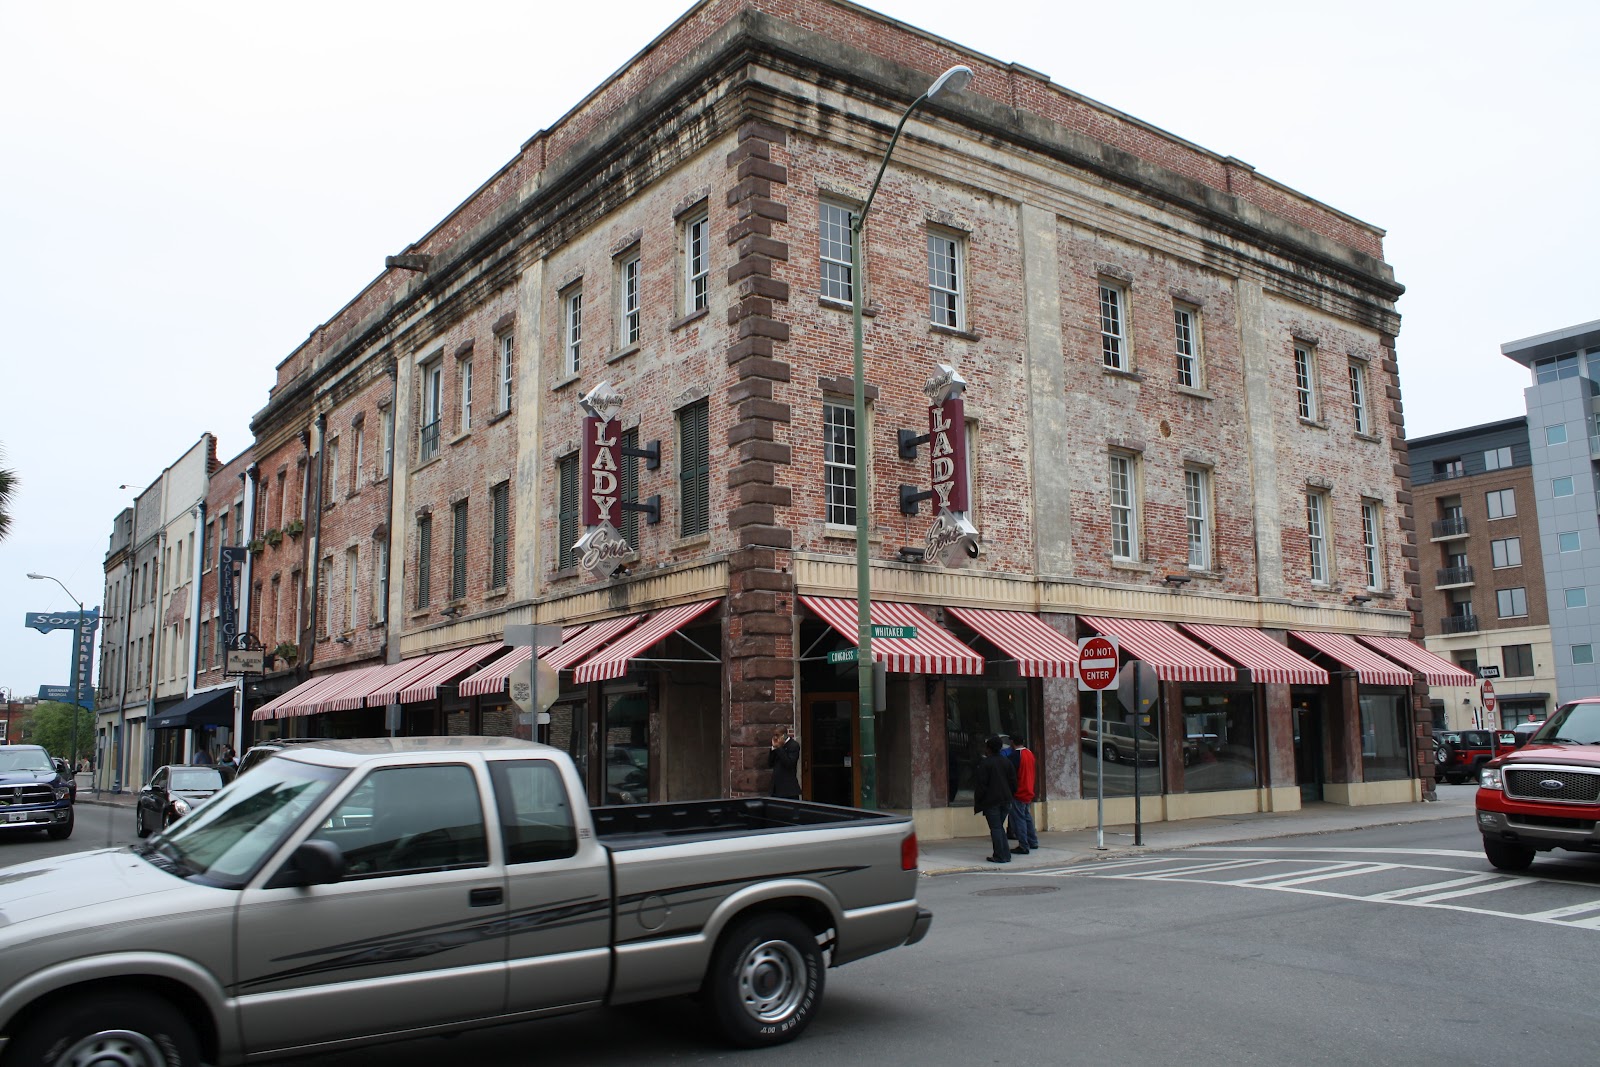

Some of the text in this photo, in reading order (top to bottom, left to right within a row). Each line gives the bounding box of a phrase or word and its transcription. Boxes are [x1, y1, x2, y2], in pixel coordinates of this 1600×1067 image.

[932, 407, 955, 507] LADY
[592, 422, 618, 520] LADY
[582, 528, 634, 570] Sons
[223, 549, 234, 620] SAPPHIRE
[33, 615, 98, 626] Sorry
[875, 627, 904, 637] WHITAKER
[831, 650, 854, 662] CONGRESS
[1084, 647, 1112, 657] DO NOT
[1086, 670, 1110, 680] ENTER
